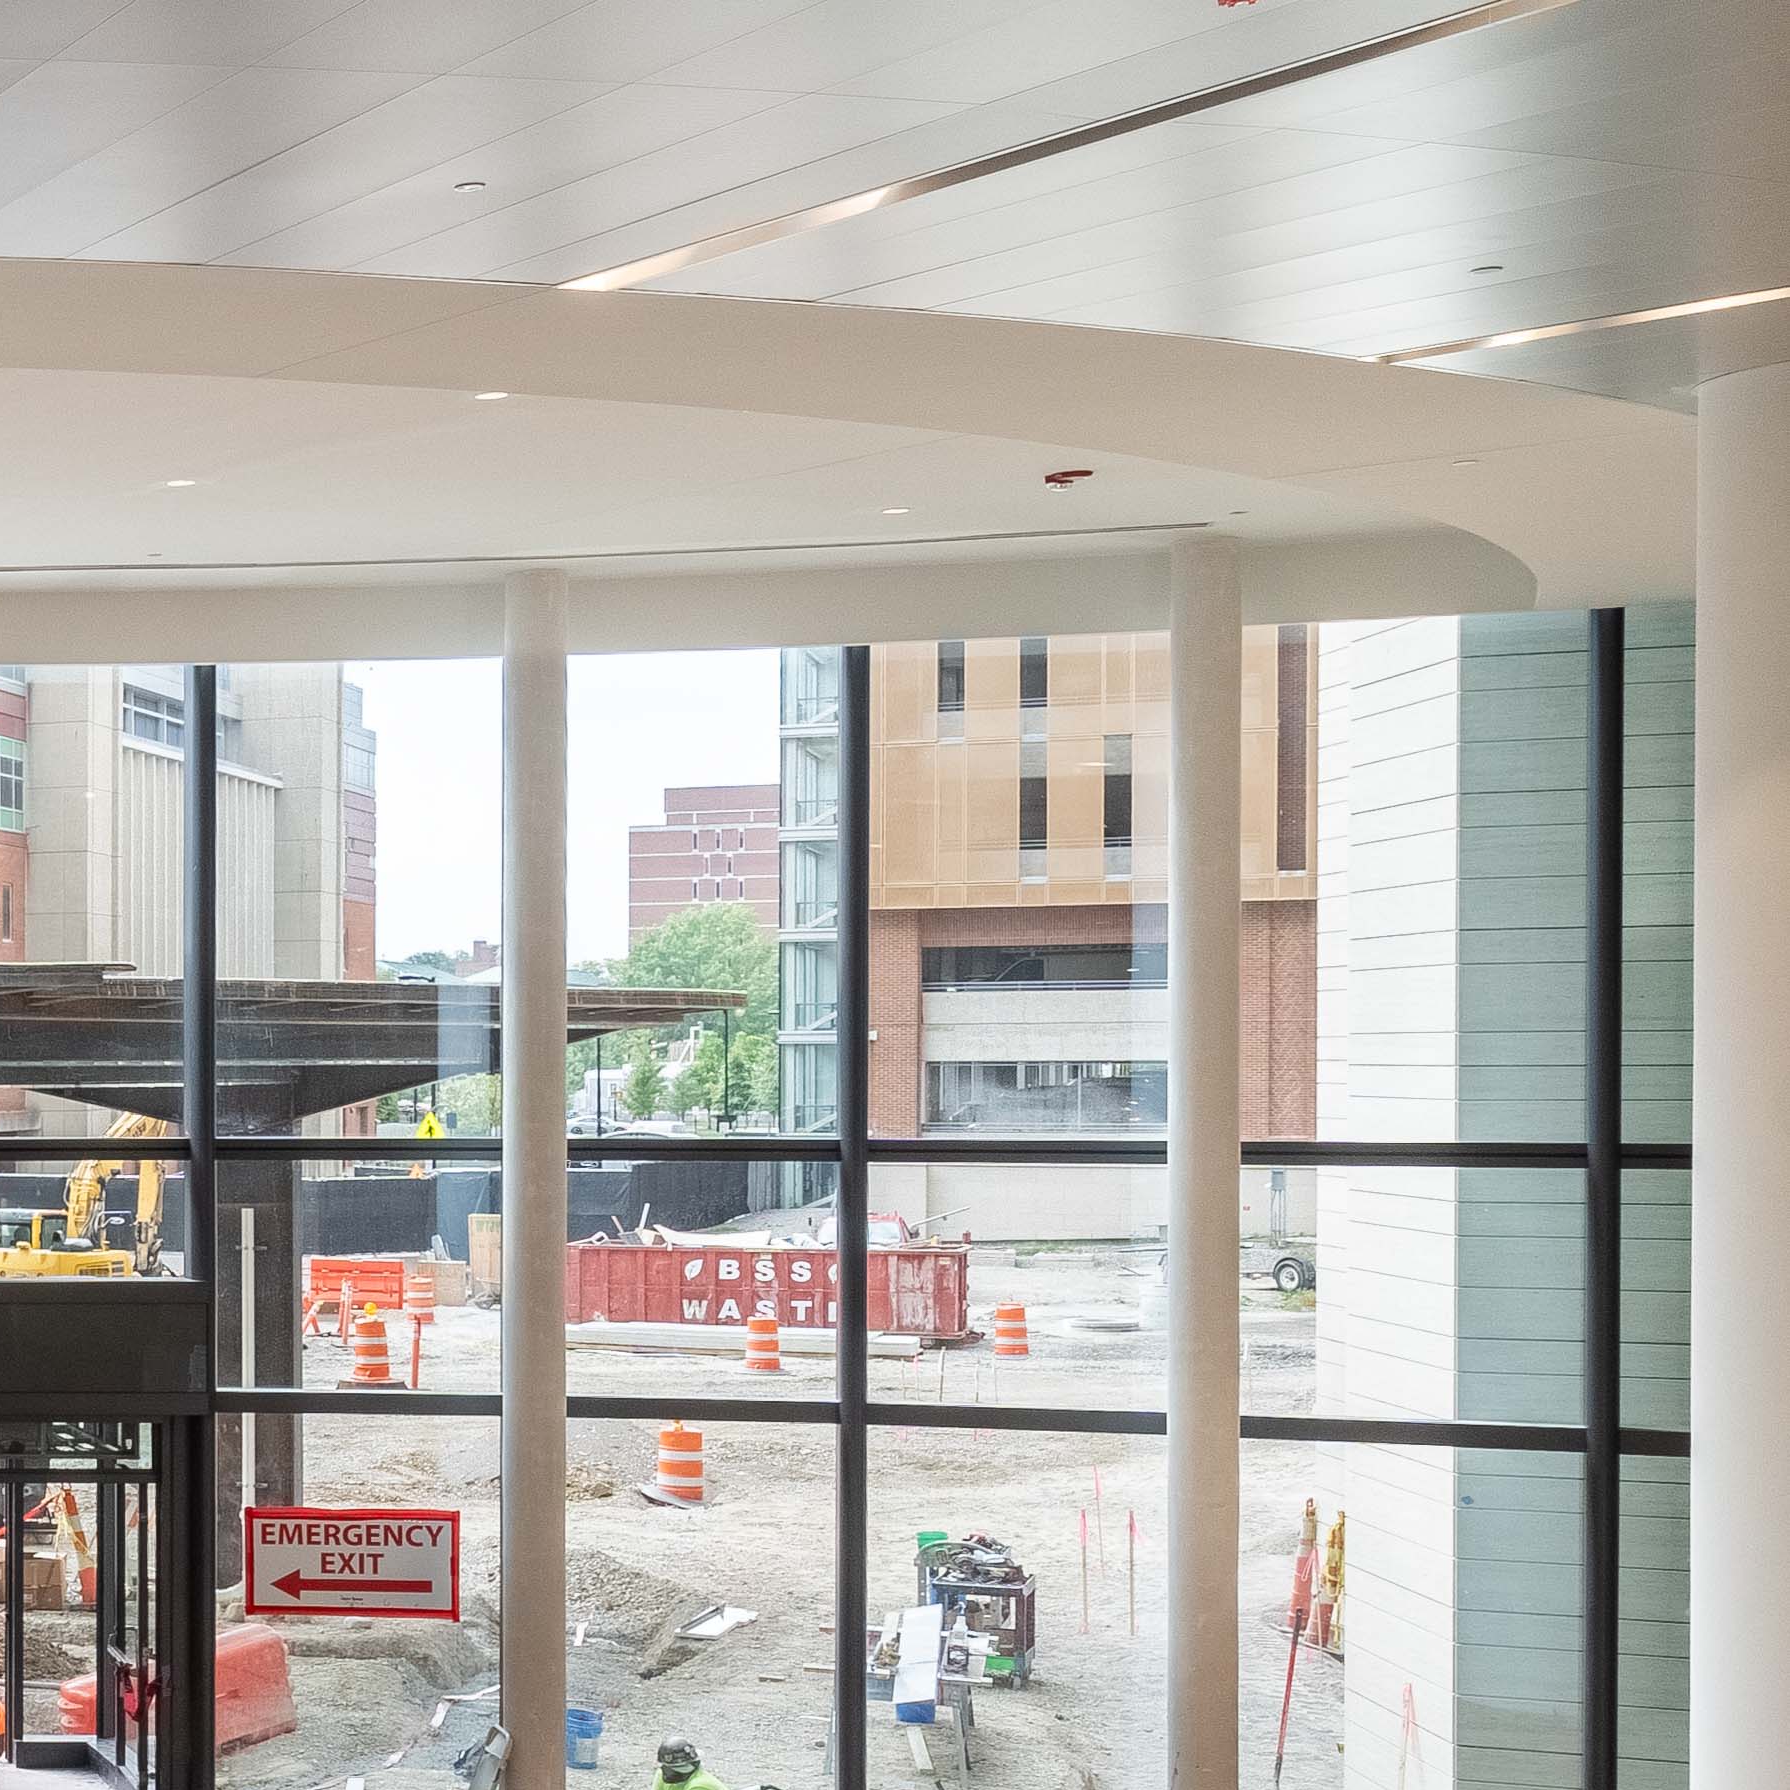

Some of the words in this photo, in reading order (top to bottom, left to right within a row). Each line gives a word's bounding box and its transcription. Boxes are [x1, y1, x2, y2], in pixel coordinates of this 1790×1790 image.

[718, 1258, 812, 1283] BSS
[260, 1523, 444, 1548] EMERGENCY
[320, 1552, 385, 1576] EXIT
